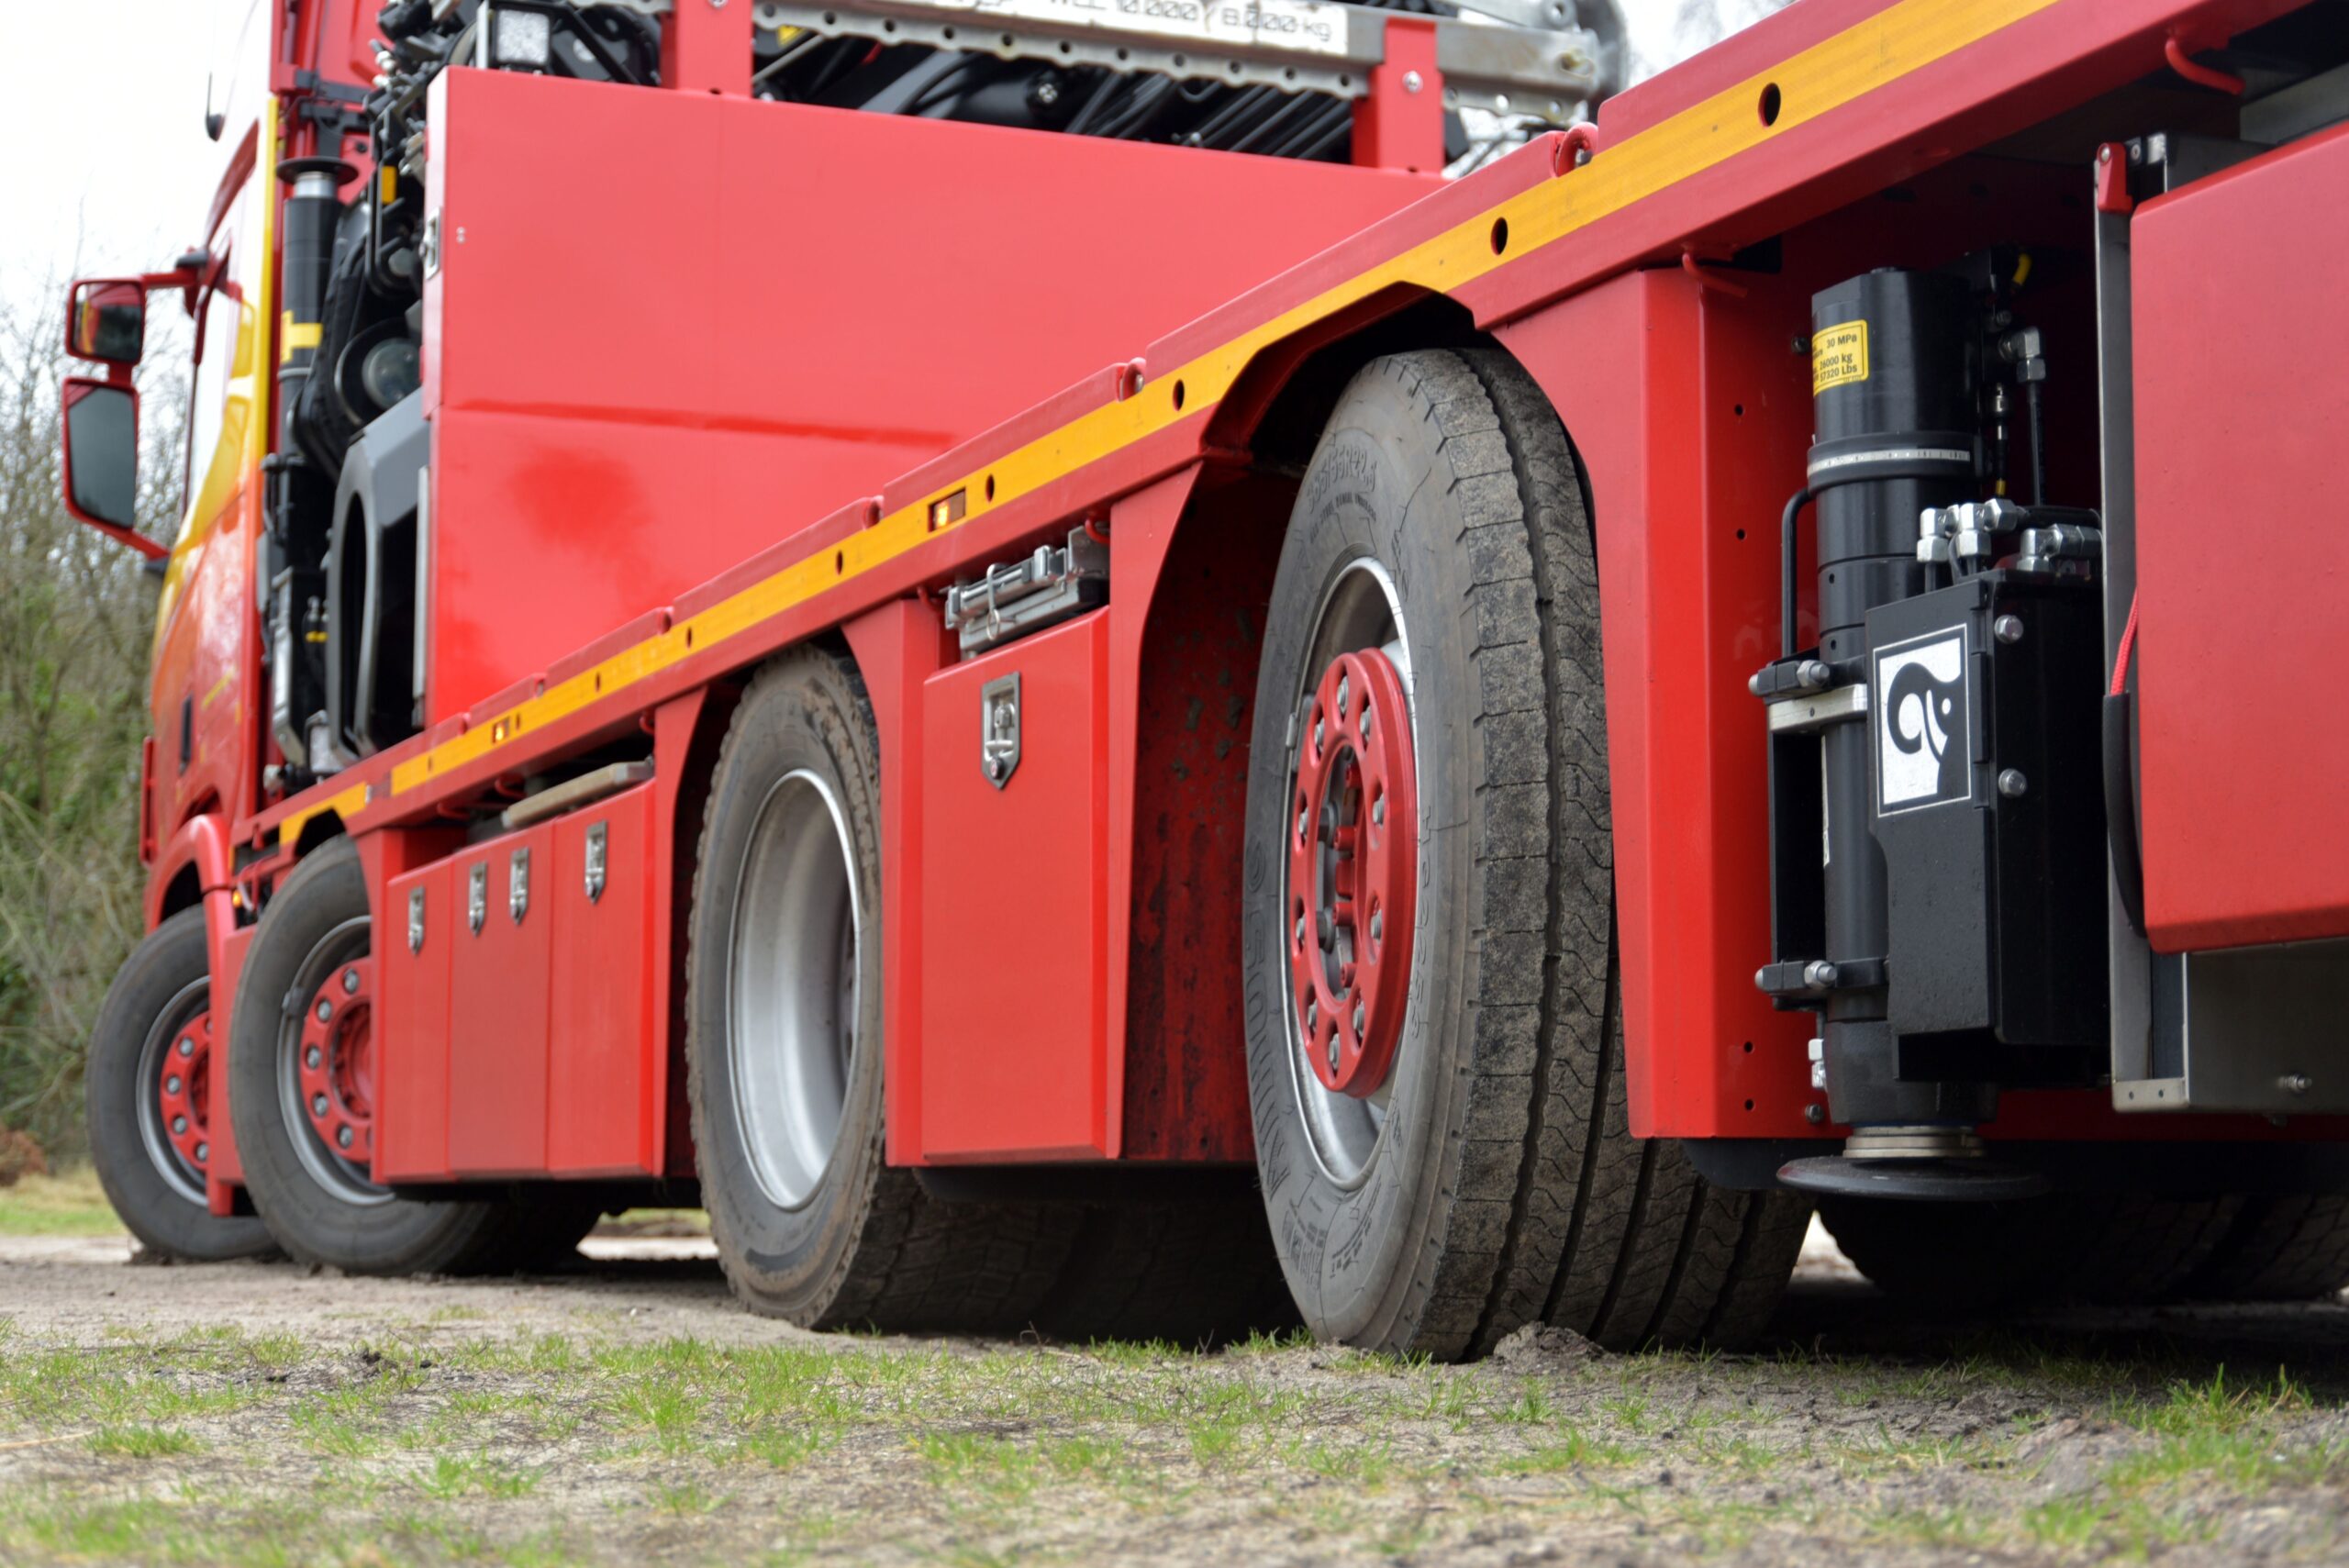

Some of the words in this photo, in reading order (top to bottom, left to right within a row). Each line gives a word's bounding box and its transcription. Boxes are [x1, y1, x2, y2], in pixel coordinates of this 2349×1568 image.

[1304, 17, 1331, 42] kg
[1827, 338, 1835, 349] 30
[1838, 334, 1857, 345] MPa
[1842, 353, 1853, 364] kg
[1842, 363, 1857, 374] Lbs
